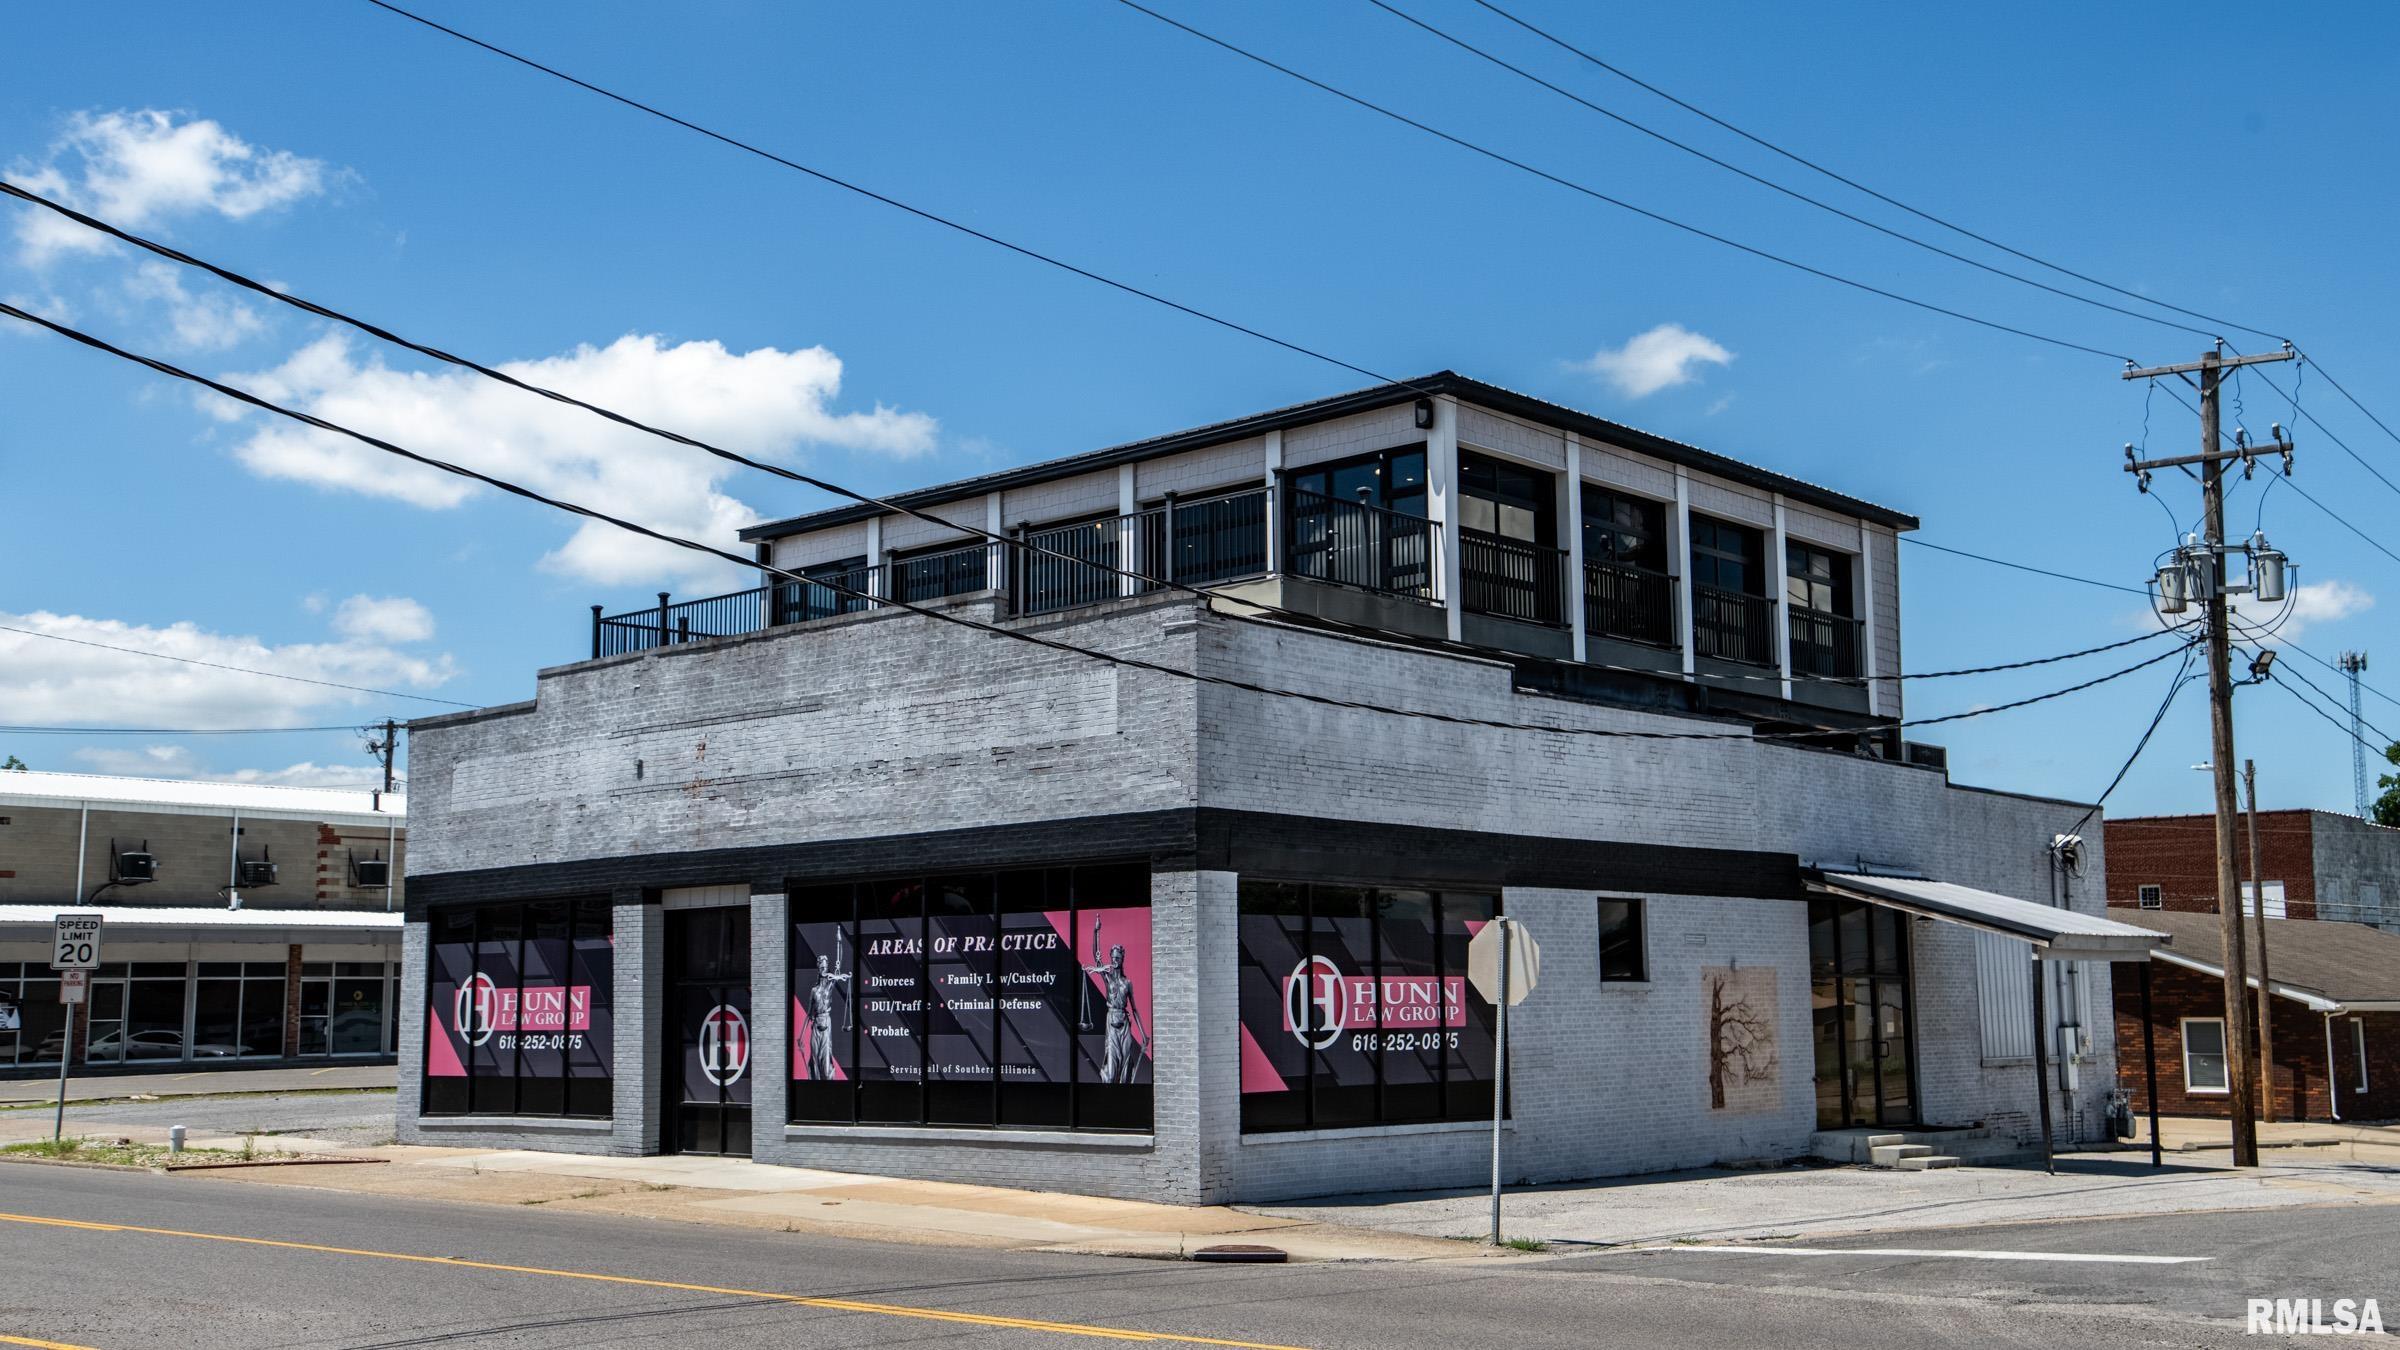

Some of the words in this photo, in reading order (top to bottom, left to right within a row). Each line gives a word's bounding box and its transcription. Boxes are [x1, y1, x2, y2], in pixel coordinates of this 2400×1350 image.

[59, 921, 98, 930] SPEED
[62, 932, 93, 941] LIMIT
[59, 943, 93, 963] 20
[868, 939, 923, 955] AREAS
[934, 937, 957, 953] OF
[871, 976, 915, 987] Divorces
[947, 974, 983, 987] Family
[986, 971, 1057, 986] Lw/Custody
[1352, 982, 1460, 1005] HUNN
[502, 991, 586, 1012] HUNN
[871, 1000, 932, 1014] DUI/Traffc
[947, 998, 994, 1010] Criminal
[999, 998, 1042, 1010] Defense
[502, 1012, 532, 1025] LAW
[1354, 1007, 1394, 1022] LAW
[1399, 1006, 1460, 1022] GROUP
[871, 1025, 910, 1037] Probate
[499, 1034, 582, 1050] 618-252-0875
[1352, 1032, 1459, 1052] 618-252-085
[890, 1065, 922, 1076] Serving
[928, 1064, 939, 1073] all
[942, 1064, 951, 1073] of
[1000, 1065, 1036, 1075] Illinois
